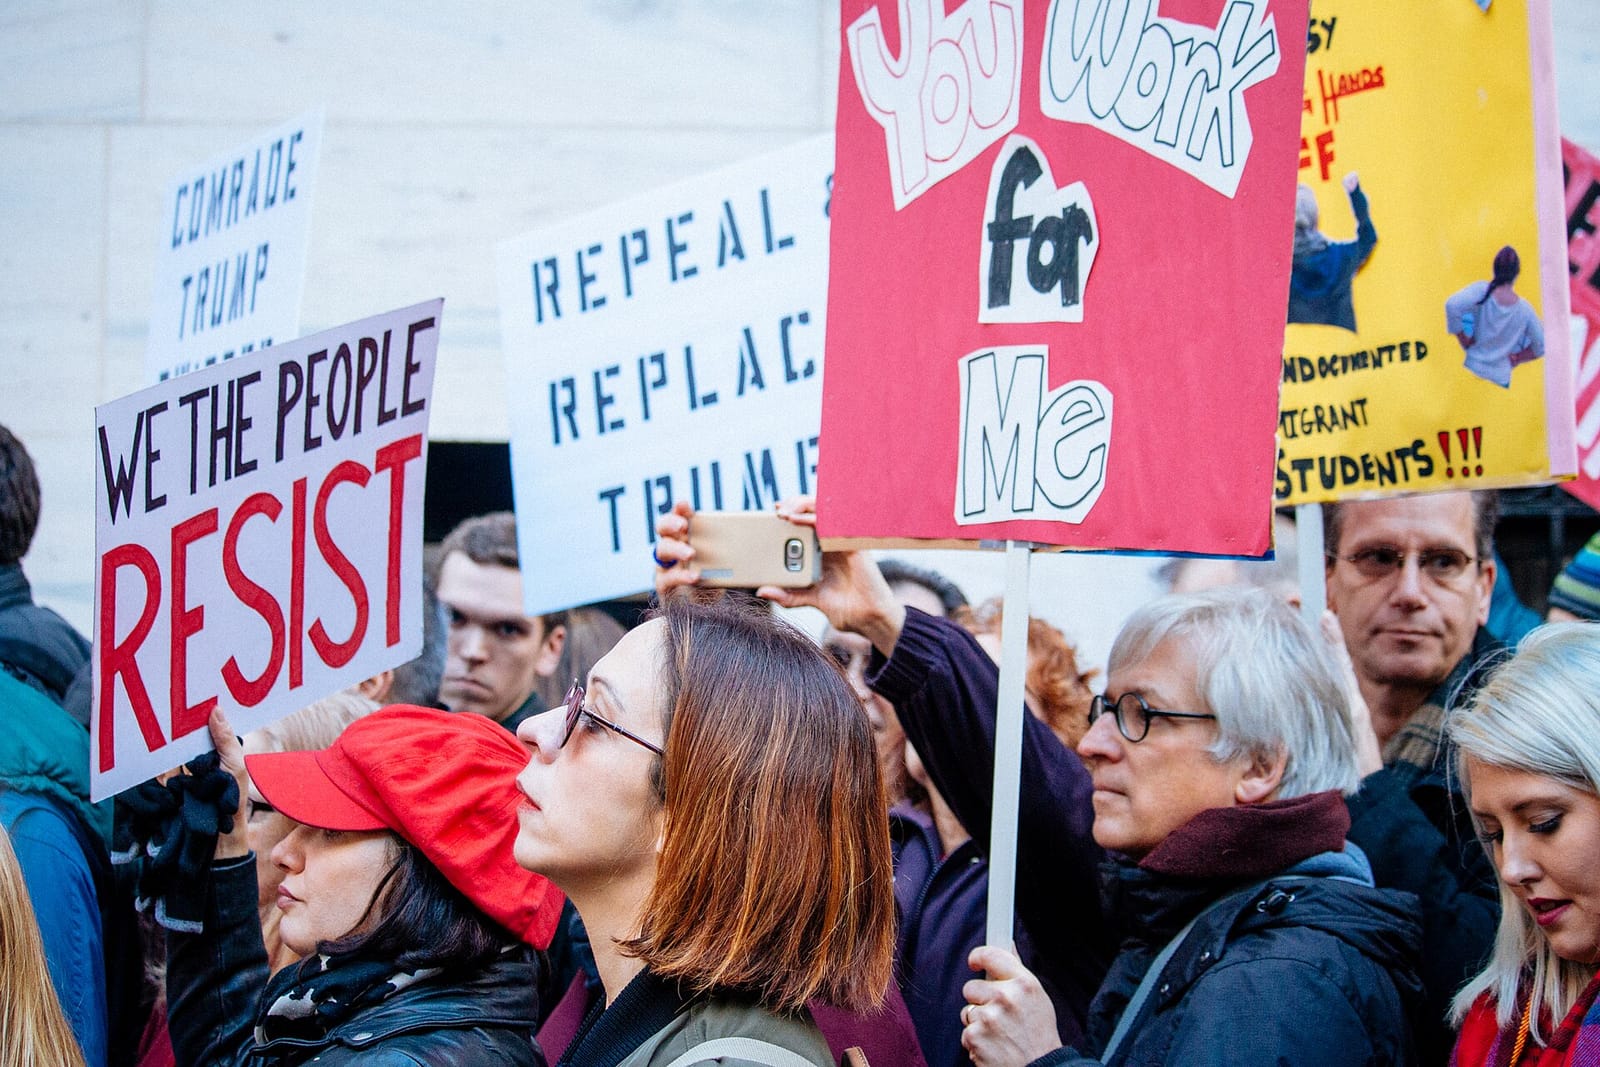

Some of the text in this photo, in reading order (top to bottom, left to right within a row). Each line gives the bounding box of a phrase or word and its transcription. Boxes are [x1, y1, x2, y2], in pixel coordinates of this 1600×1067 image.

[856, 0, 1275, 195] You Work
[1307, 17, 1337, 54] SY
[171, 129, 303, 249] COMRADE
[532, 188, 795, 324] REPEAL
[987, 145, 1093, 309] for
[178, 243, 270, 341] TRUMP
[98, 317, 436, 526] WE THE PEOPLE
[549, 311, 815, 446] REPLAC
[1283, 341, 1428, 383] NDOCUMENTED
[963, 352, 1106, 517] Me
[99, 433, 423, 774] RESIST
